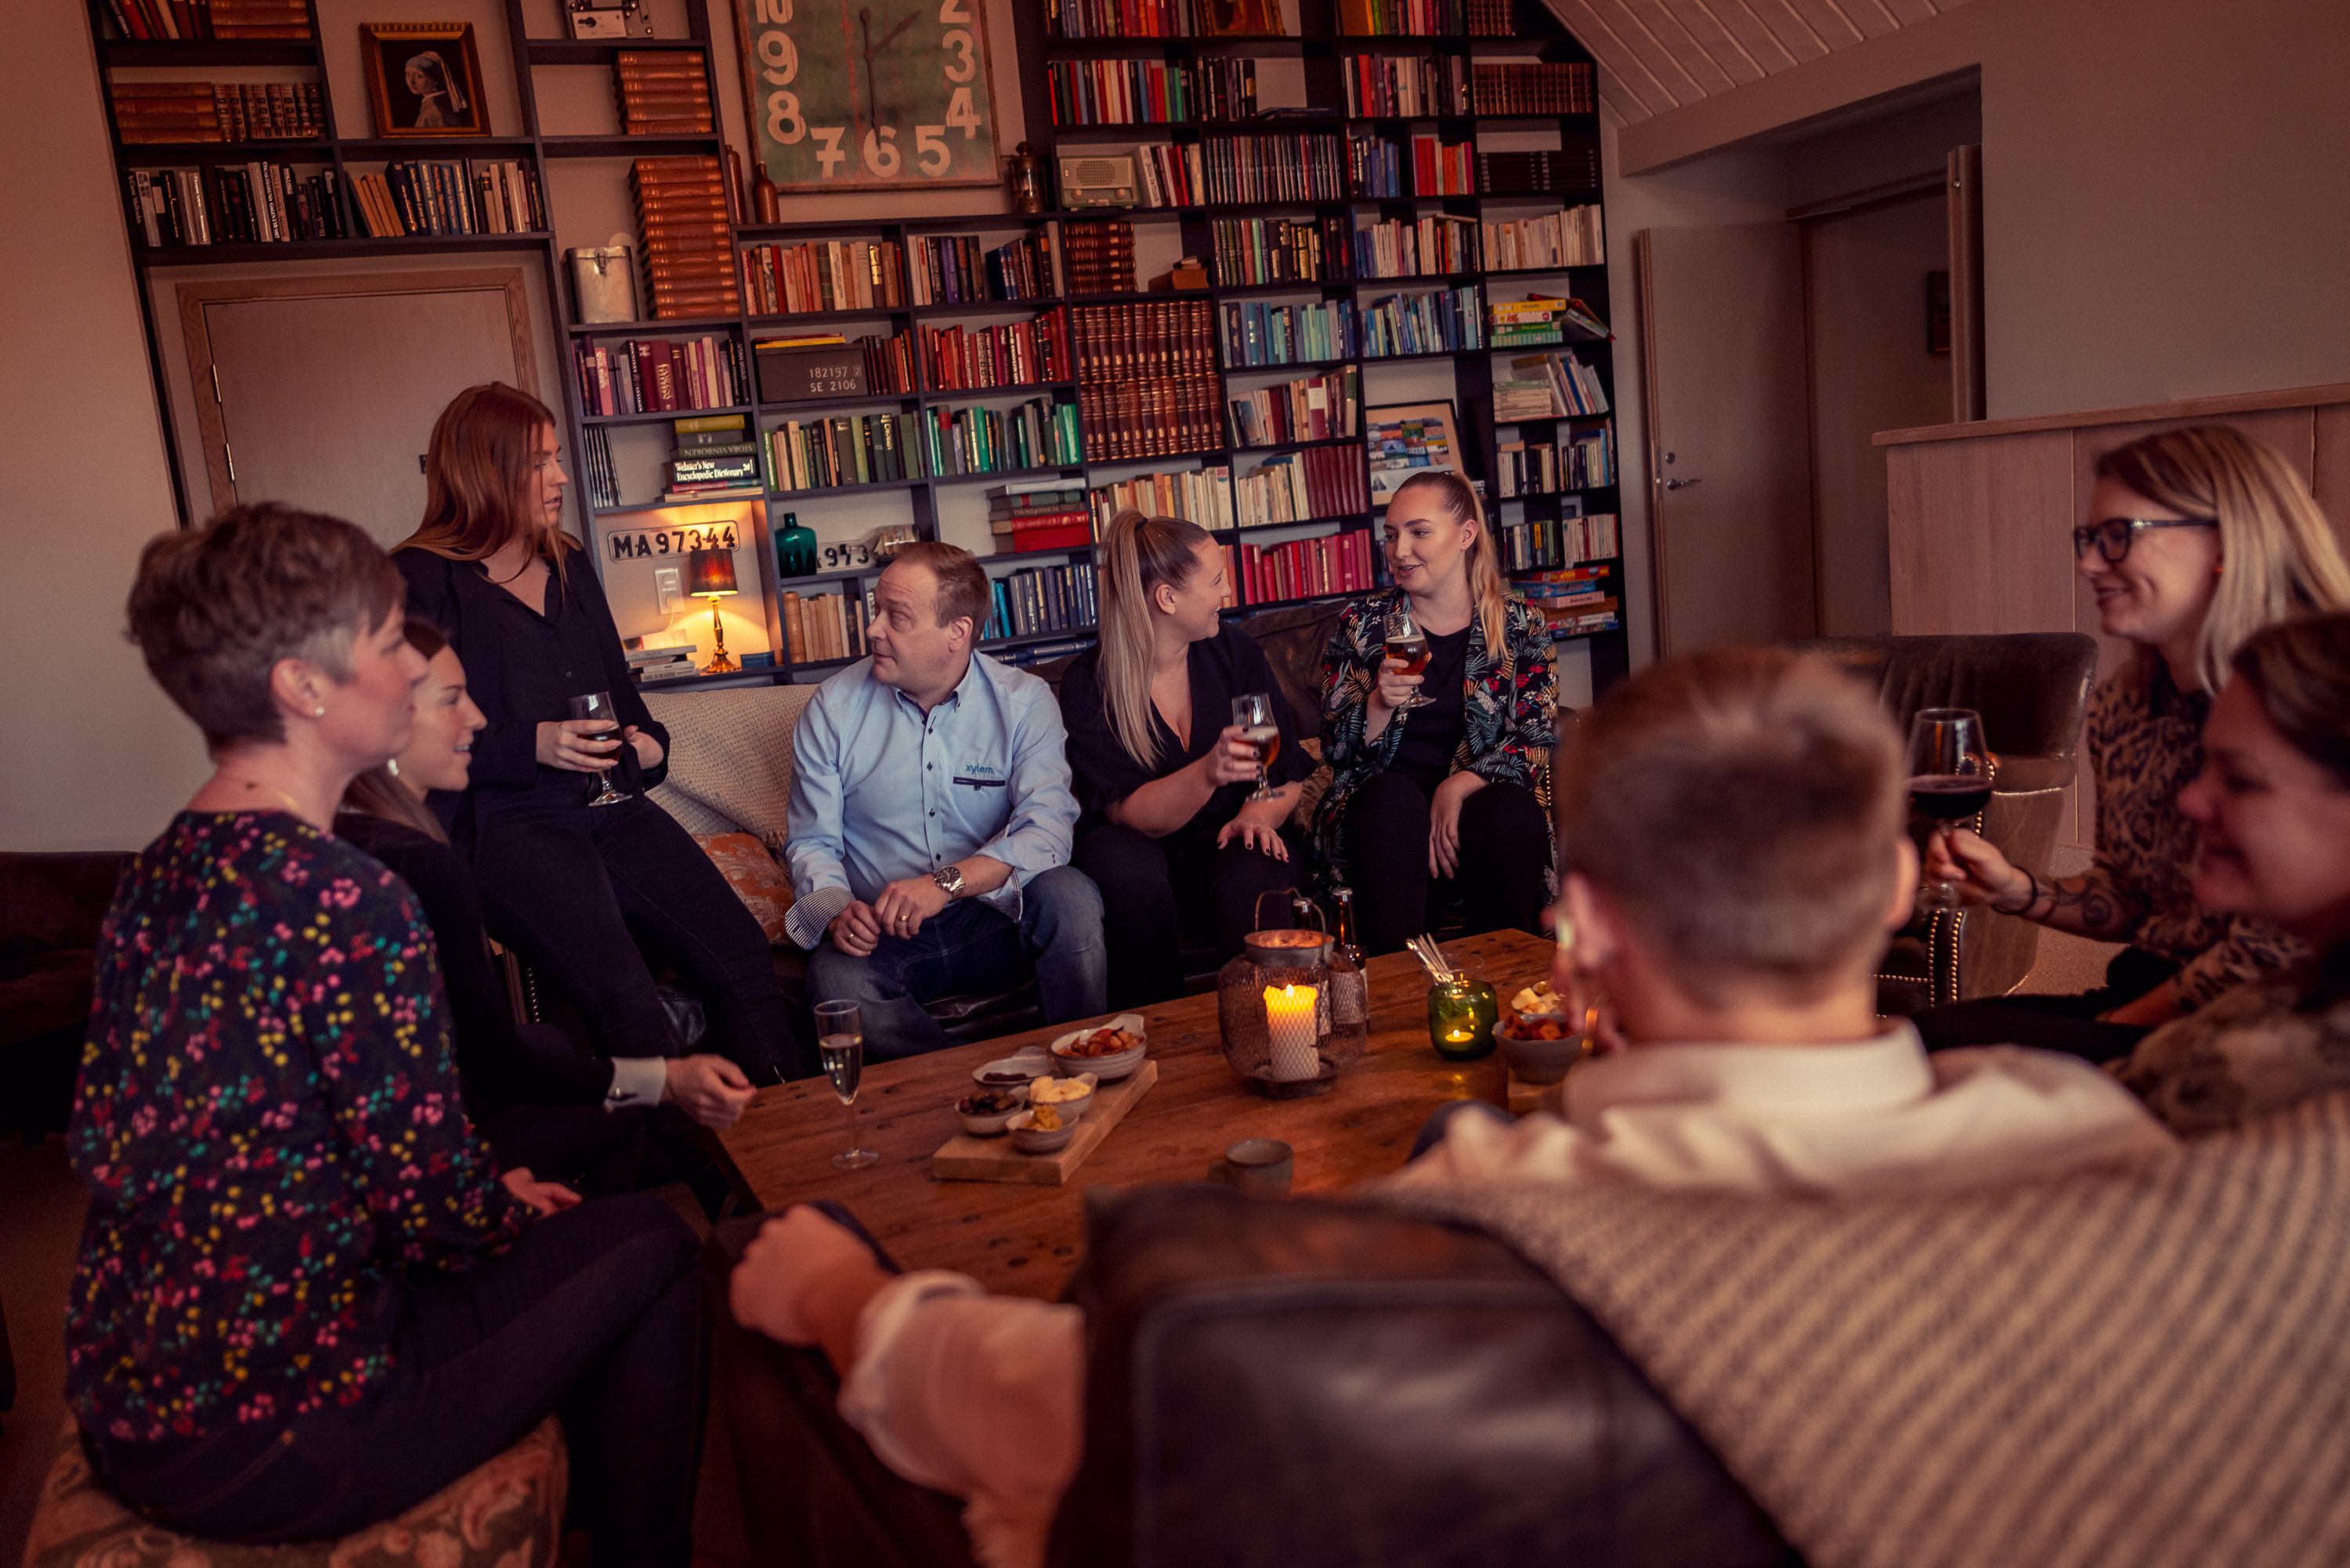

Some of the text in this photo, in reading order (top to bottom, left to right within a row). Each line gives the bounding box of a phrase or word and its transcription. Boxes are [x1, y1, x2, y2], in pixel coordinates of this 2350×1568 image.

[757, 30, 799, 86] 9
[942, 29, 977, 83] 3
[767, 90, 807, 145] 8
[945, 87, 982, 139] 4
[809, 366, 848, 378] 182197
[810, 378, 856, 392] SE 2106
[685, 445, 753, 457] STORA VINBOKEN
[674, 461, 715, 471] Webster's New
[676, 470, 714, 482] Encyclopedic
[714, 468, 743, 479] Dictionary
[965, 763, 993, 775] xylem
